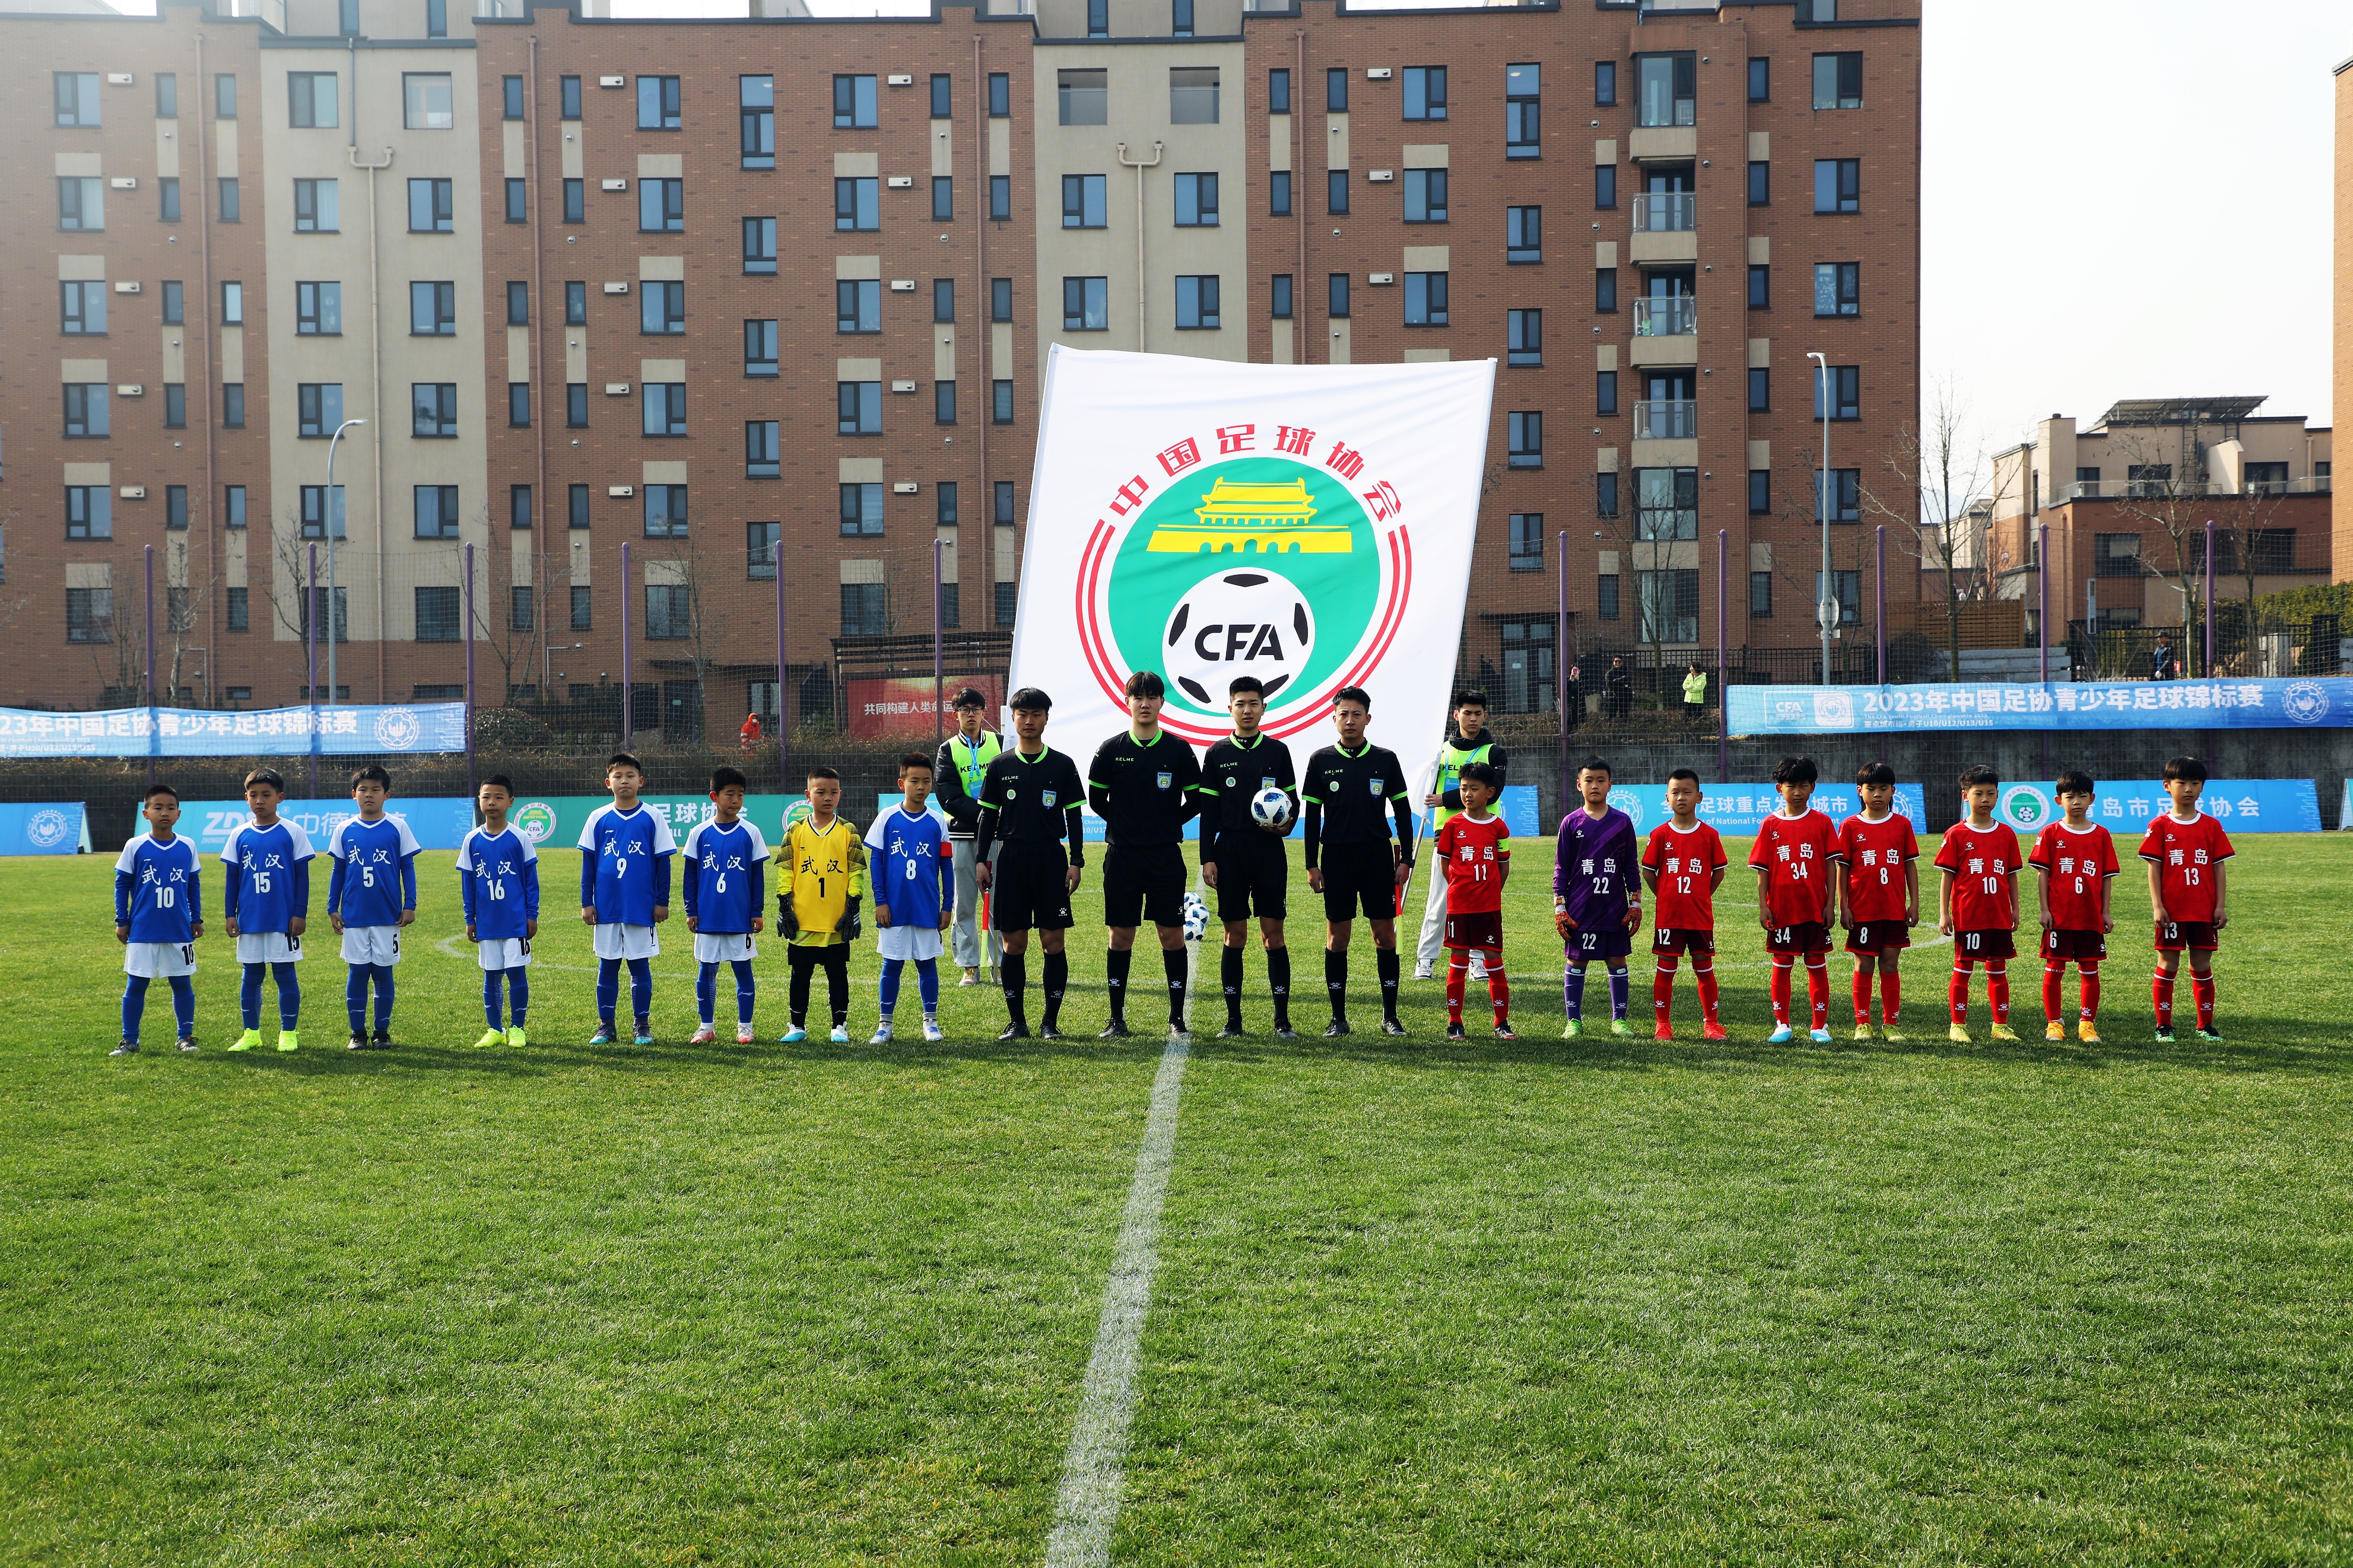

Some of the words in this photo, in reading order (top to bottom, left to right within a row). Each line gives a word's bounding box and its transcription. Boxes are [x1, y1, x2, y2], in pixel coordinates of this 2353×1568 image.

[1109, 424, 1401, 522] 中国足球协会
[1195, 624, 1284, 661] CFA
[1776, 702, 1802, 712] CFA
[1863, 684, 2265, 713] 2023年中国足协青少年足球锦标赛
[1716, 816, 1751, 825] National
[348, 845, 391, 866] 武汉
[604, 837, 645, 857] 武汉
[891, 837, 932, 858] 武汉
[1460, 845, 1494, 861] 青岛
[1777, 842, 1813, 862] 青岛
[242, 850, 284, 871] 武汉
[703, 851, 745, 872] 武汉
[801, 855, 843, 875] 武汉
[1581, 857, 1616, 875] 青岛
[1666, 857, 1703, 874] 青岛
[1861, 848, 1899, 866] 青岛
[1968, 858, 2005, 875] 青岛
[2168, 848, 2208, 866] 青岛
[142, 865, 186, 885] 武汉
[475, 859, 516, 879] 武汉
[617, 858, 627, 879] 9
[906, 859, 916, 880] 8
[1474, 864, 1487, 881] 11
[1790, 861, 1808, 880] 34
[1879, 867, 1888, 885] 8
[2059, 857, 2096, 877] 青岛
[2184, 867, 2199, 885] 13
[253, 872, 271, 893] 15
[363, 866, 373, 888] 5
[716, 872, 726, 893] 6
[1593, 877, 1609, 894] 22
[1676, 876, 1691, 893] 12
[1982, 877, 1997, 894] 10
[2075, 877, 2083, 894] 6
[487, 879, 505, 901] 16
[818, 877, 825, 898] 1
[155, 887, 174, 908] 10
[1447, 921, 1454, 938] 11
[1658, 928, 1671, 945] 12
[1774, 927, 1790, 943] 34
[1860, 927, 1868, 943] 8
[2164, 922, 2177, 939] 13
[285, 933, 300, 952] 15
[392, 933, 399, 954] 5
[518, 939, 531, 956] 16
[1582, 933, 1596, 949] 22
[1965, 933, 1980, 950] 10
[2050, 931, 2057, 948] 6
[182, 944, 194, 966] 10
